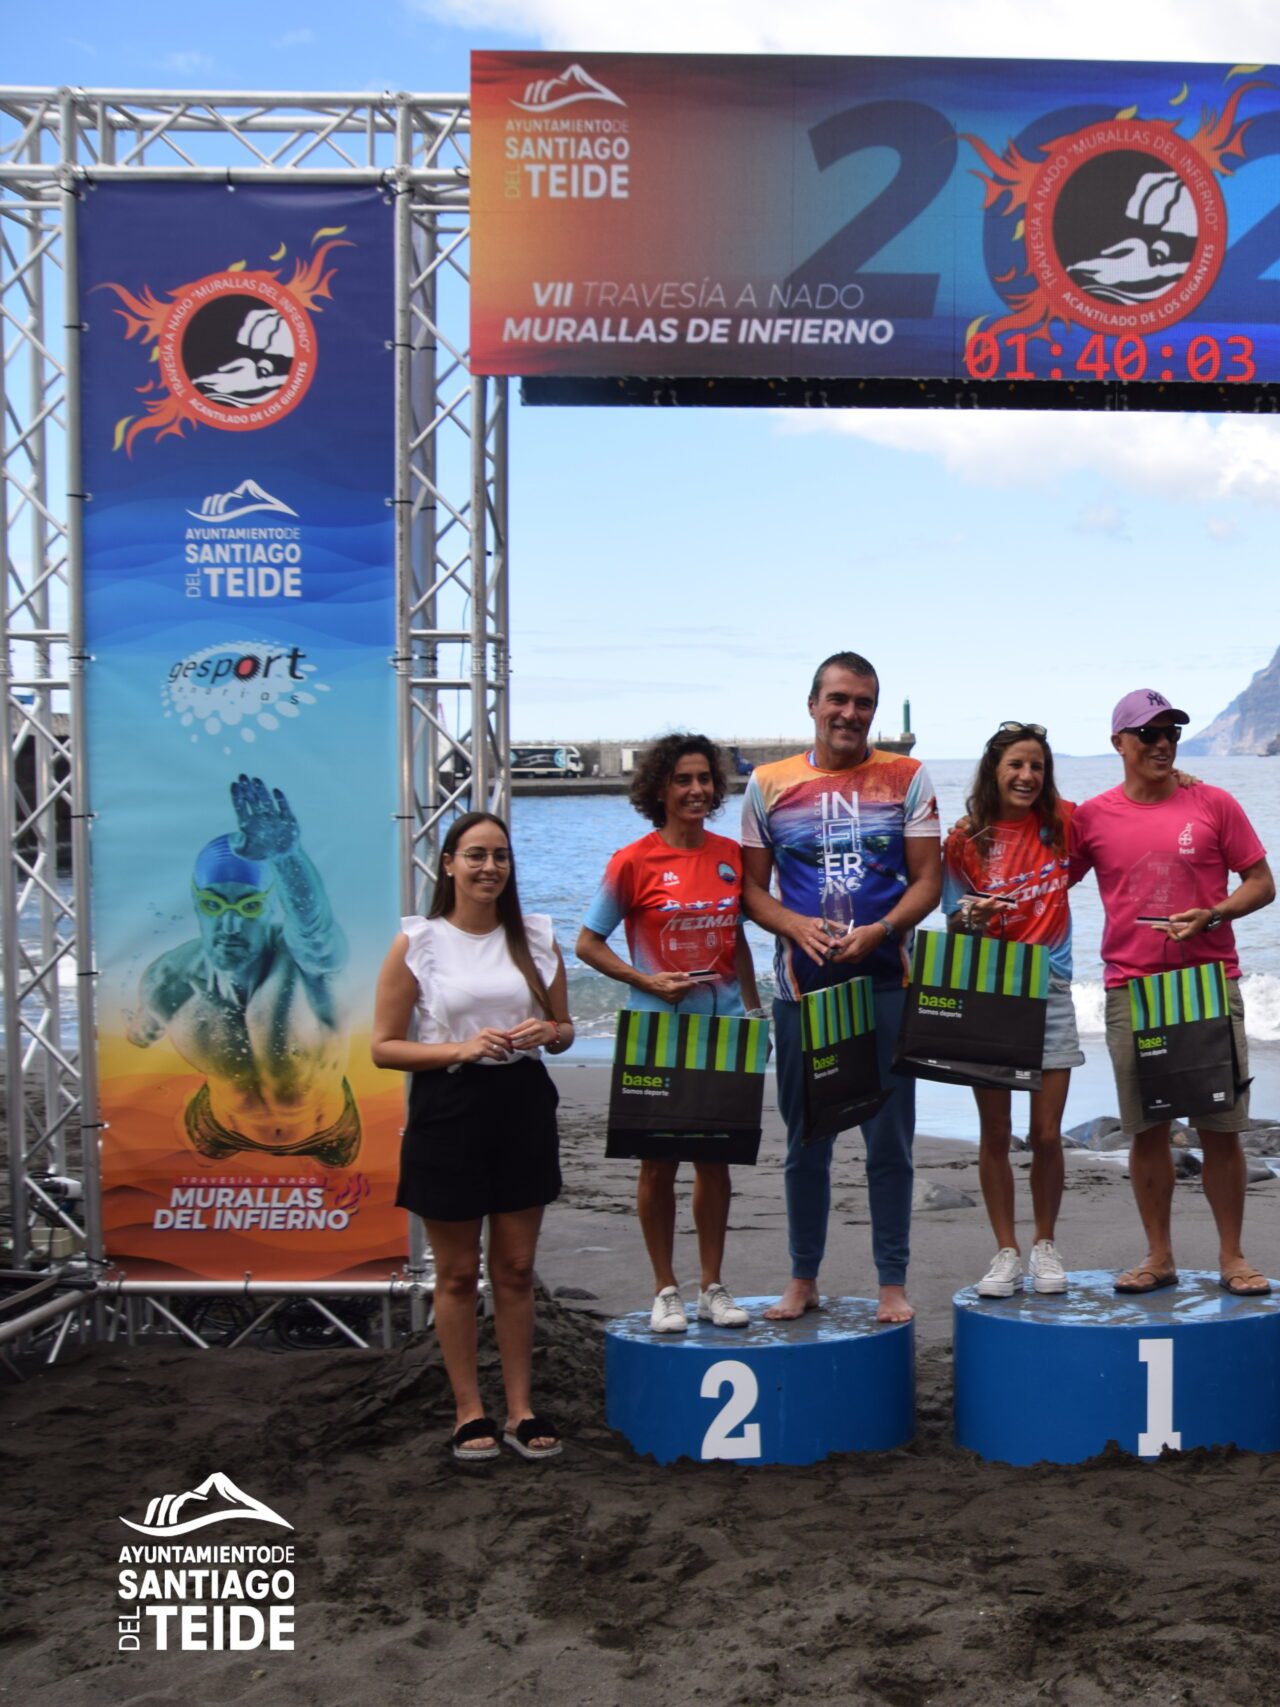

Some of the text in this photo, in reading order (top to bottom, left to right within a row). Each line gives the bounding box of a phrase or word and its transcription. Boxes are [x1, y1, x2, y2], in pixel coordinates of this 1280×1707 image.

[505, 137, 630, 160] SANTIAGO
[1152, 136, 1178, 160] DEL
[505, 164, 521, 198] DEL
[524, 163, 630, 199] TEIDE
[1036, 156, 1070, 199] NADO
[1033, 201, 1045, 213] A
[1029, 215, 1058, 288] TRAVESÍA
[257, 282, 279, 301] DEL
[533, 276, 865, 310] VII TRAVESÍA A NADO
[1061, 243, 1215, 328] ACANTILADO DE LOS GIGANTES
[167, 298, 194, 331] NADO
[165, 331, 176, 342] A
[502, 317, 894, 345] MURALLAS DE INFIERNO
[965, 333, 1258, 382] 01:40:03
[188, 398, 249, 424] ACANTILADO
[250, 411, 263, 423] DE
[263, 403, 282, 418] LOS
[185, 543, 302, 564] SANTIAGO
[185, 568, 201, 598] DEL
[203, 566, 302, 598] TEIDE
[167, 647, 307, 684] gesport
[821, 790, 860, 819] IN
[825, 852, 864, 877] ER
[669, 913, 740, 932] TEIMA
[261, 1176, 270, 1185] A
[278, 1176, 318, 1185] NADO
[170, 1187, 325, 1208] MURALLAS
[153, 1209, 350, 1231] DEL INFIERNO
[699, 1360, 762, 1460] 2
[1137, 1338, 1183, 1457] 1
